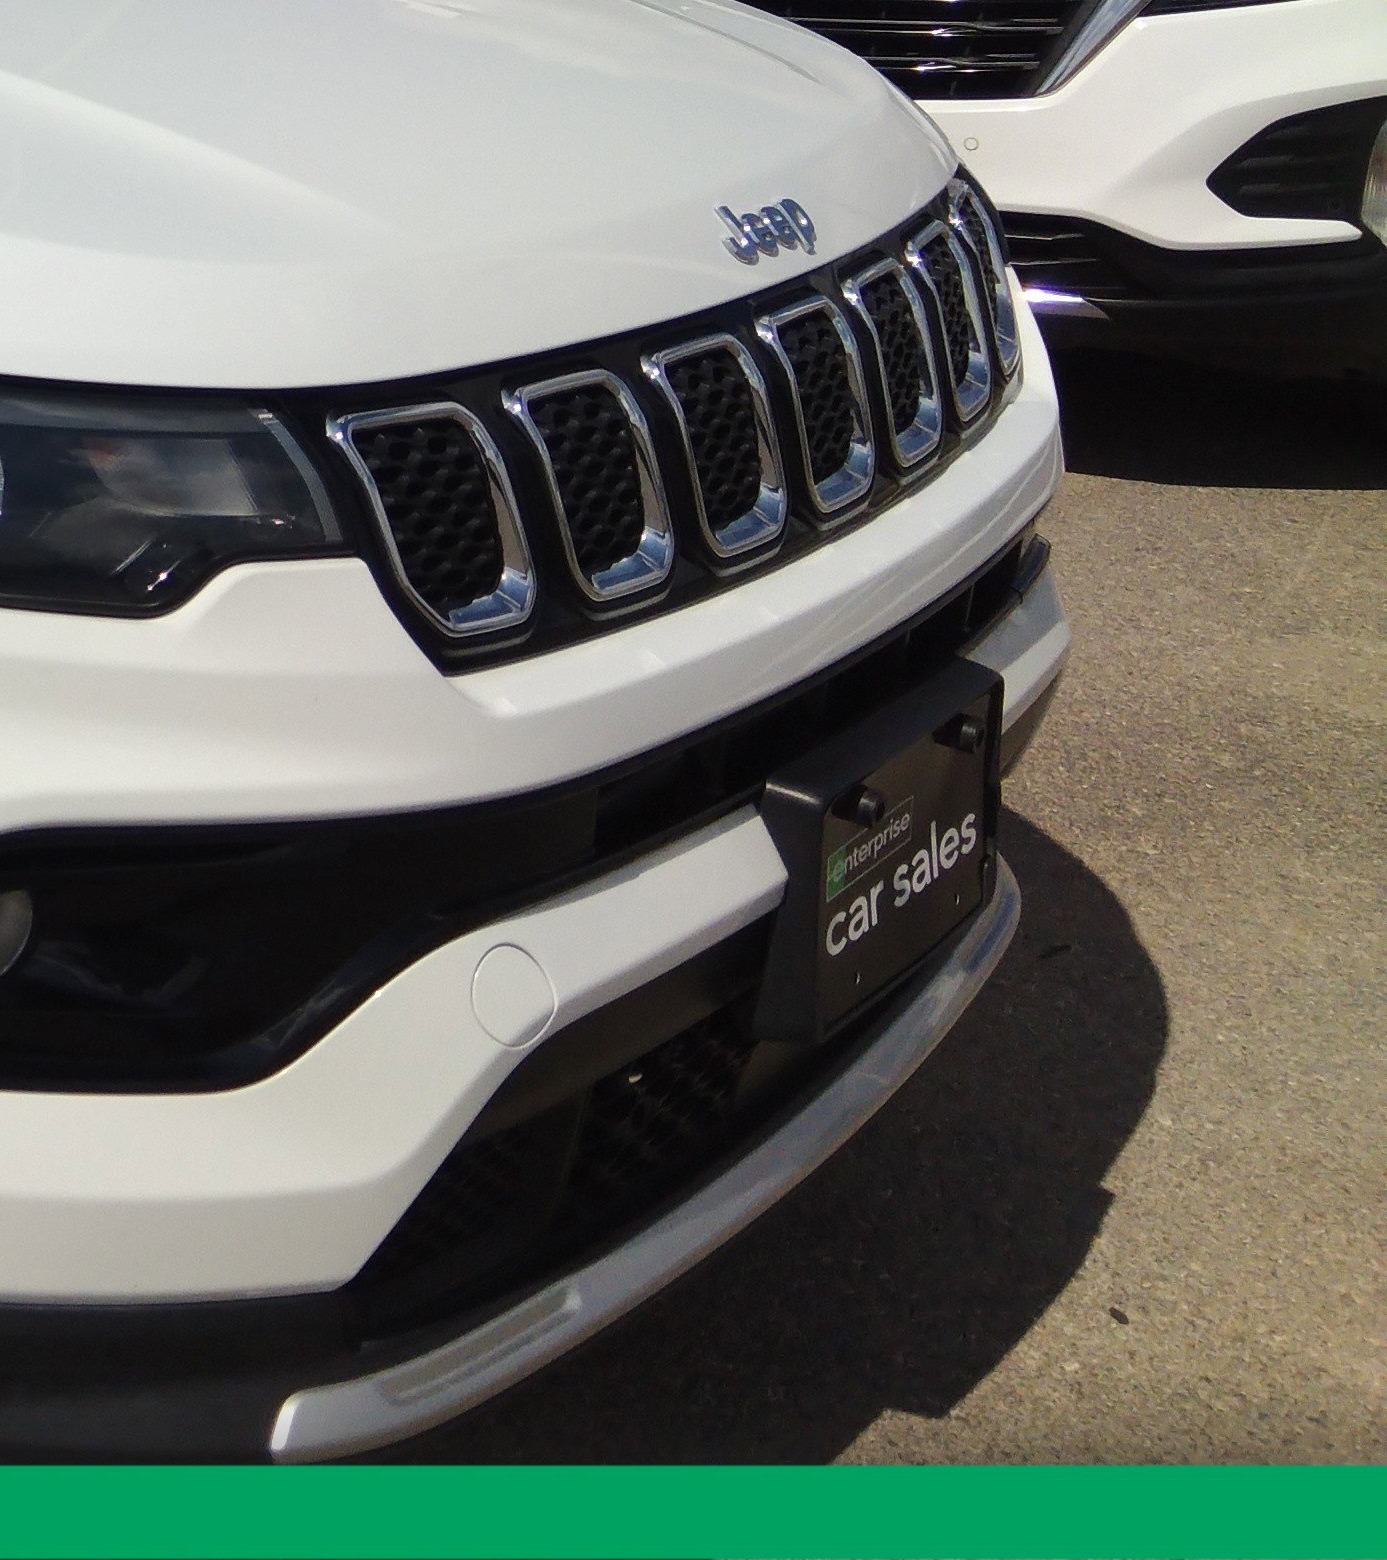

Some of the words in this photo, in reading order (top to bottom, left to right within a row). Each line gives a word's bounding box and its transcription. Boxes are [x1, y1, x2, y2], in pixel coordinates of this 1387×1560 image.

[714, 197, 818, 267] Jeep
[832, 812, 911, 883] enterprise
[825, 880, 885, 957] car
[893, 812, 977, 908] sales
